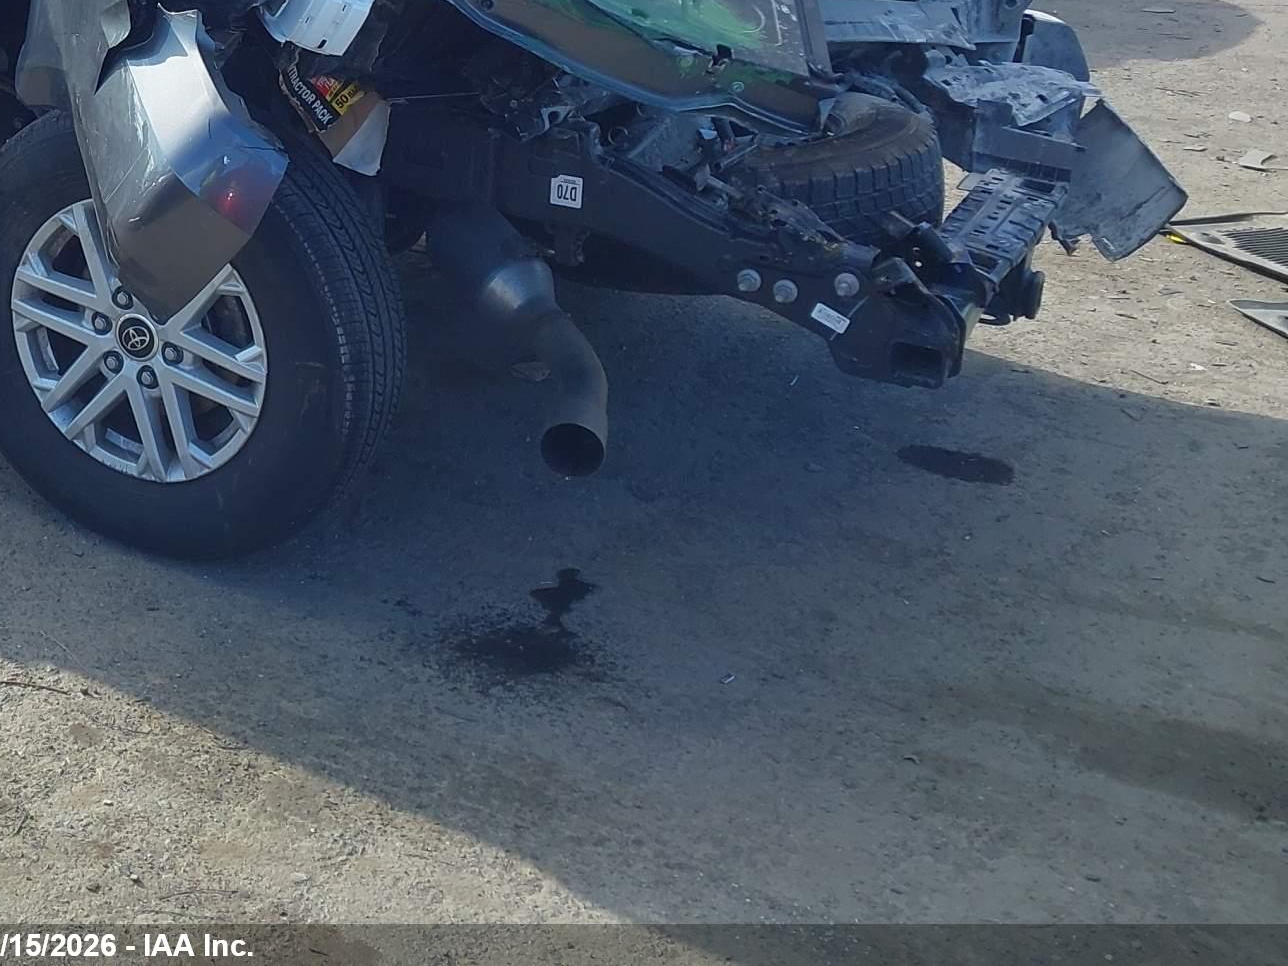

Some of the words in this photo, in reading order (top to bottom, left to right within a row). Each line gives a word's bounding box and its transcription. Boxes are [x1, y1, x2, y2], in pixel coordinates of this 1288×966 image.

[335, 94, 349, 109] 50
[311, 99, 334, 125] PACK
[556, 183, 578, 202] D70
